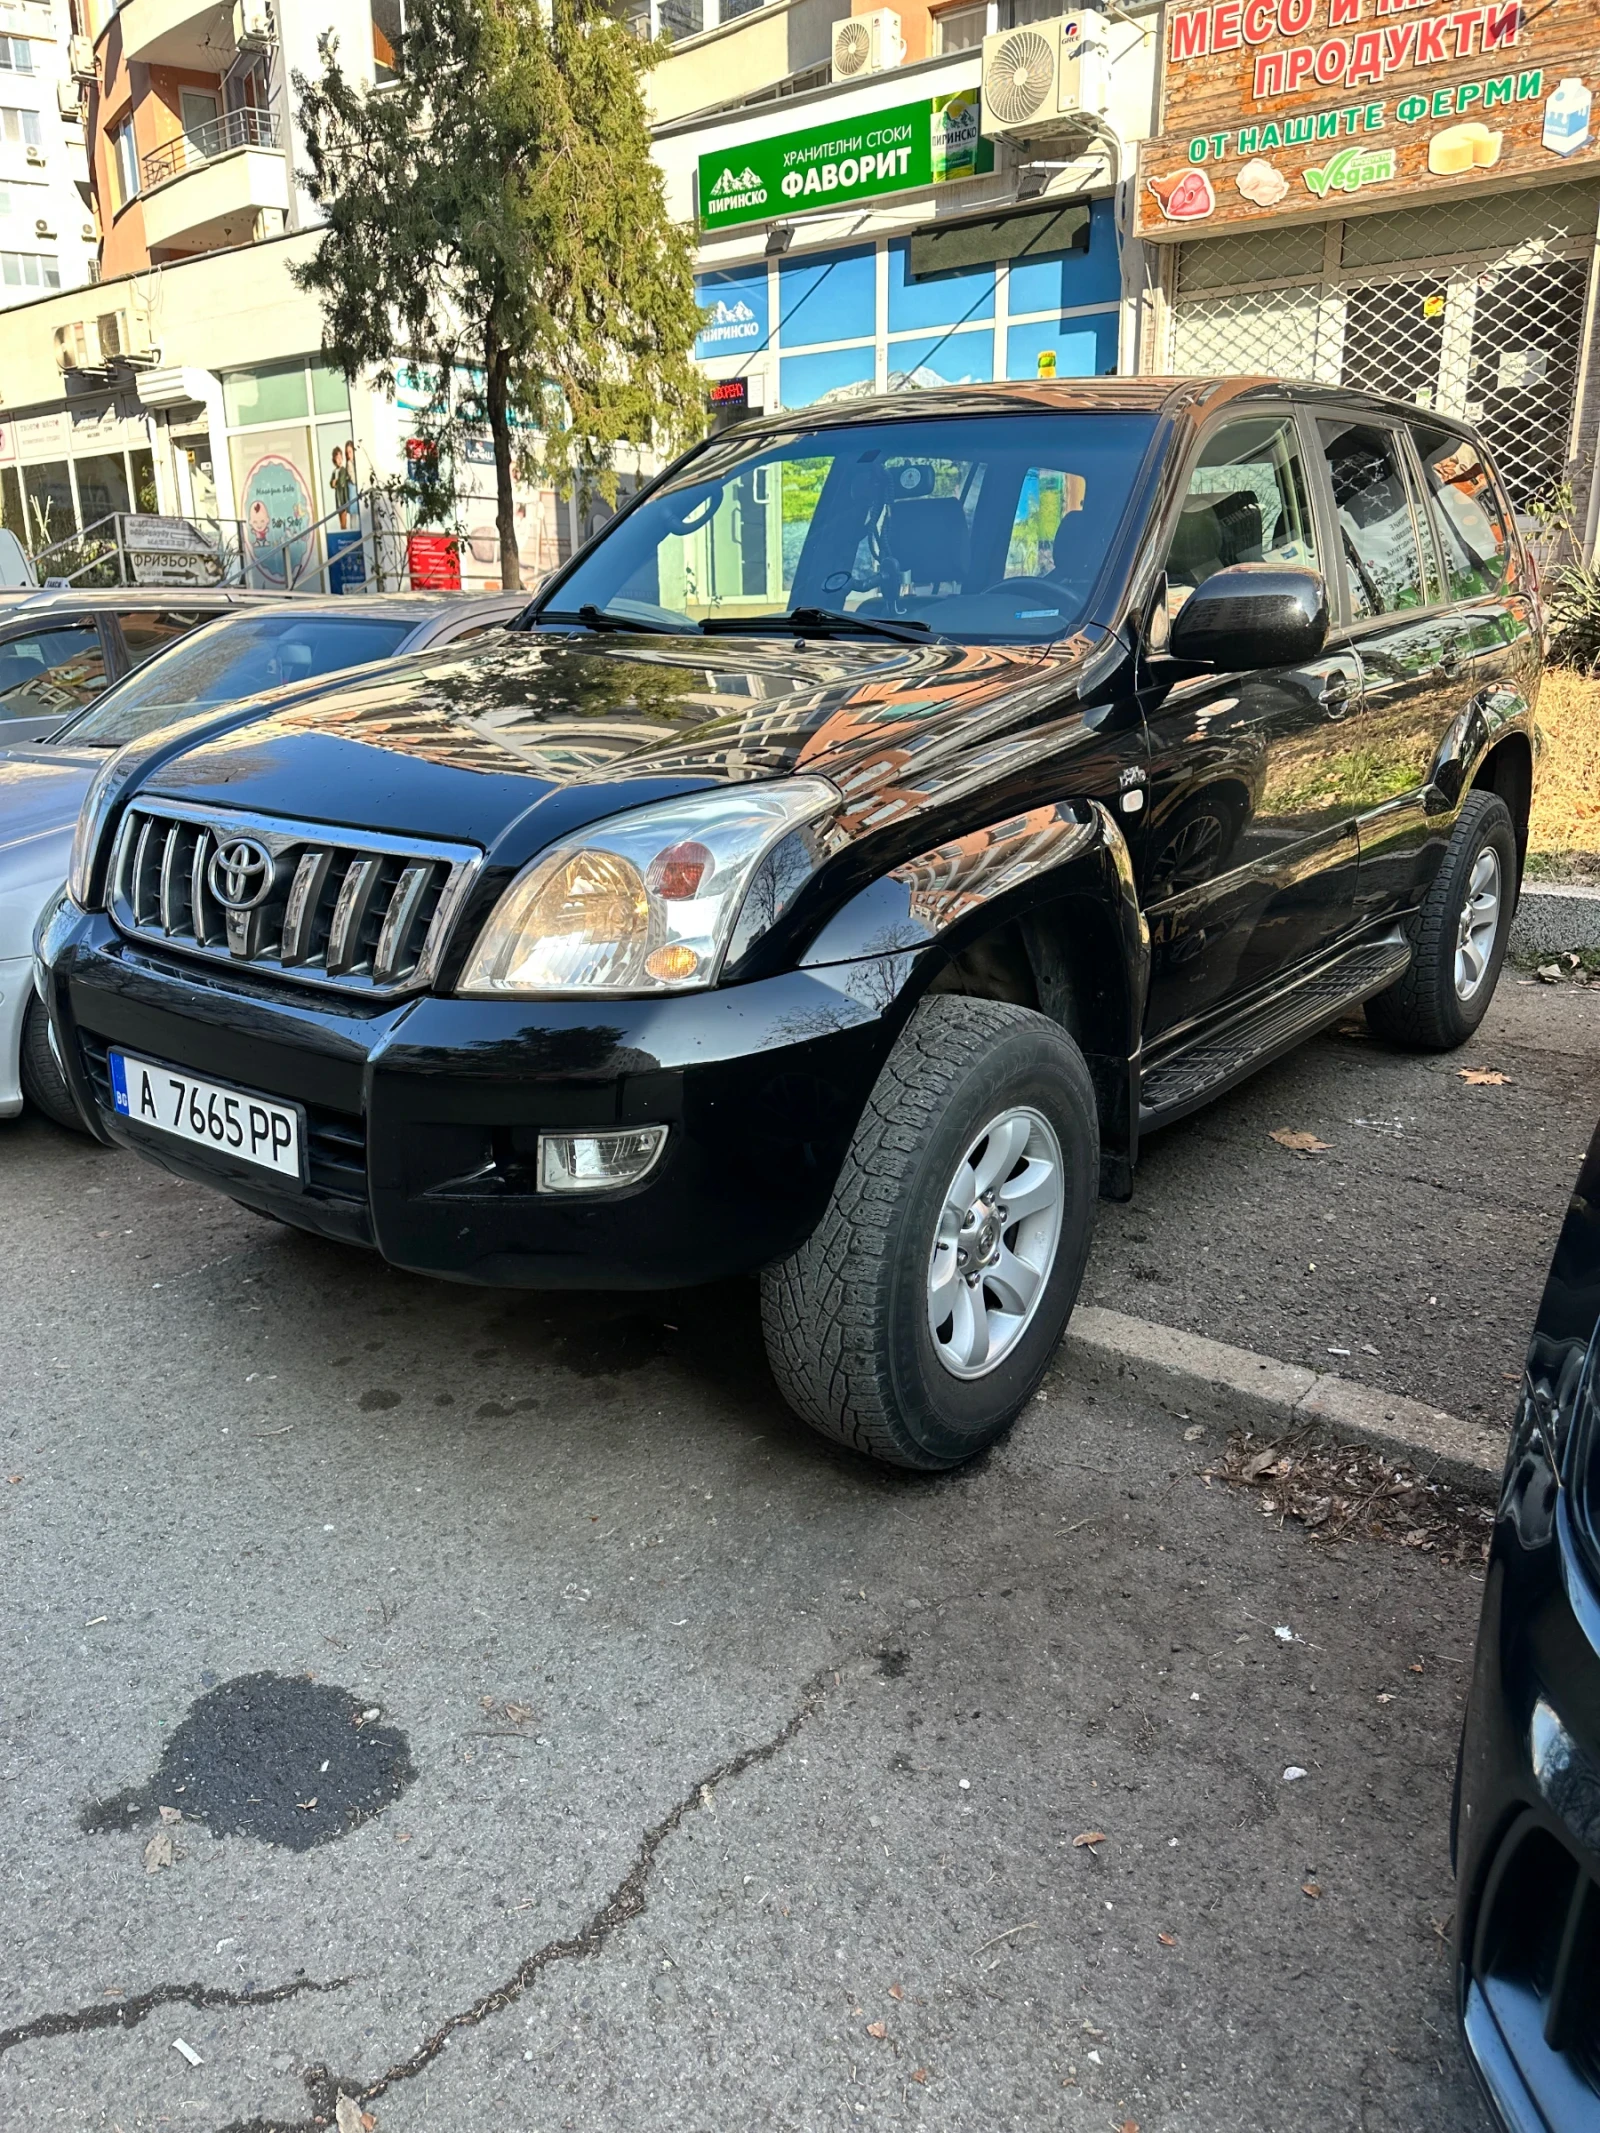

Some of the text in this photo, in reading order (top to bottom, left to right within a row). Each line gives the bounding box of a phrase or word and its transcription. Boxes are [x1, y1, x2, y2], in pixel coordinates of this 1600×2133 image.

[1061, 35, 1080, 44] GREE
[1172, 0, 1313, 59] МЕСО
[1253, 2, 1522, 99] ПРОДУКТИ
[1189, 70, 1543, 162] ОТ НАШИТЕ ФЕРМИ
[783, 124, 912, 167] ХРАНИТЕЛНИ СТОКИ
[932, 126, 977, 147] ПИРИНСКО
[781, 146, 912, 198] ФАВОРИТ
[708, 188, 768, 215] ПИРИНСКО
[703, 322, 759, 342] ПИРИНСКО
[133, 553, 197, 568] ФРИЗЬОР
[116, 1090, 128, 1107] BG
[141, 1070, 292, 1162] A 7665 PP
